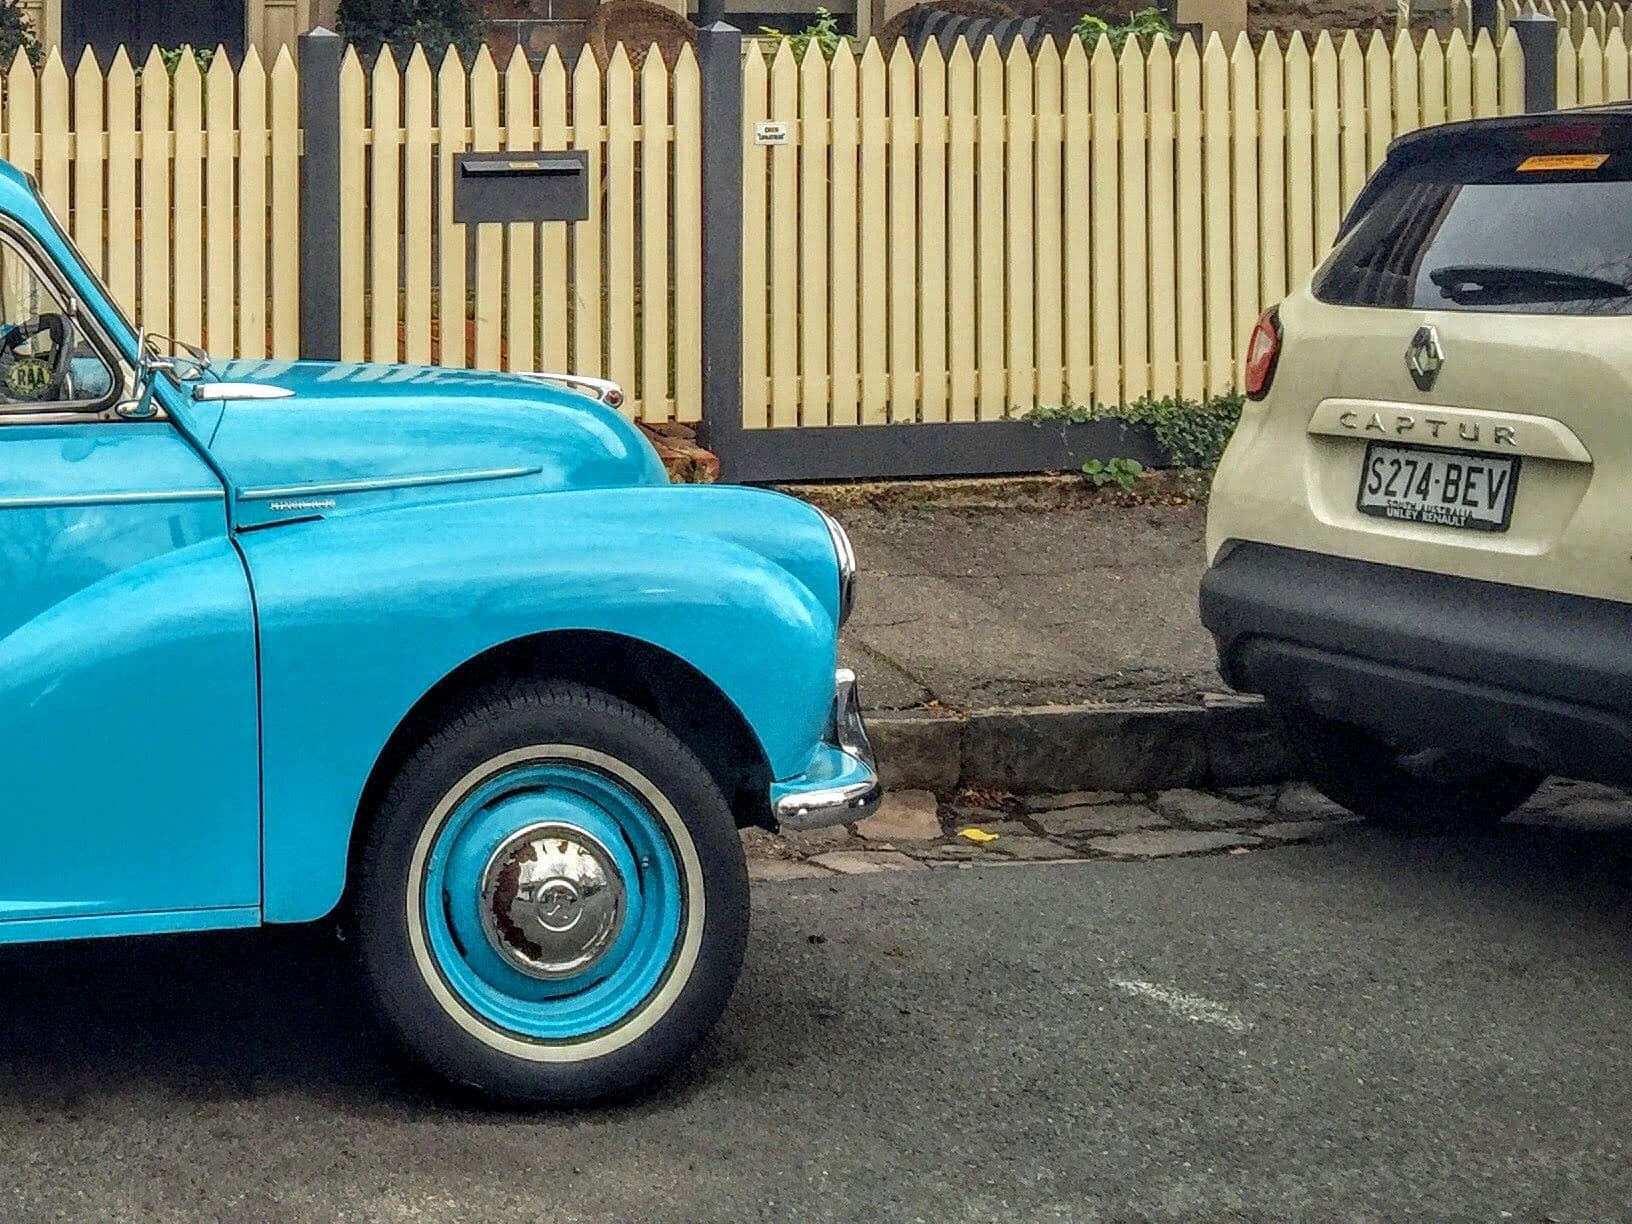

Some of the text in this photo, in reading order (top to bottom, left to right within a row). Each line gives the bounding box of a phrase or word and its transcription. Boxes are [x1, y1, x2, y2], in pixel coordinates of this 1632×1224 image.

[17, 367, 46, 386] RAA
[1339, 410, 1517, 447] CAPTUR
[1386, 507, 1467, 527] UNLEY RENAULT
